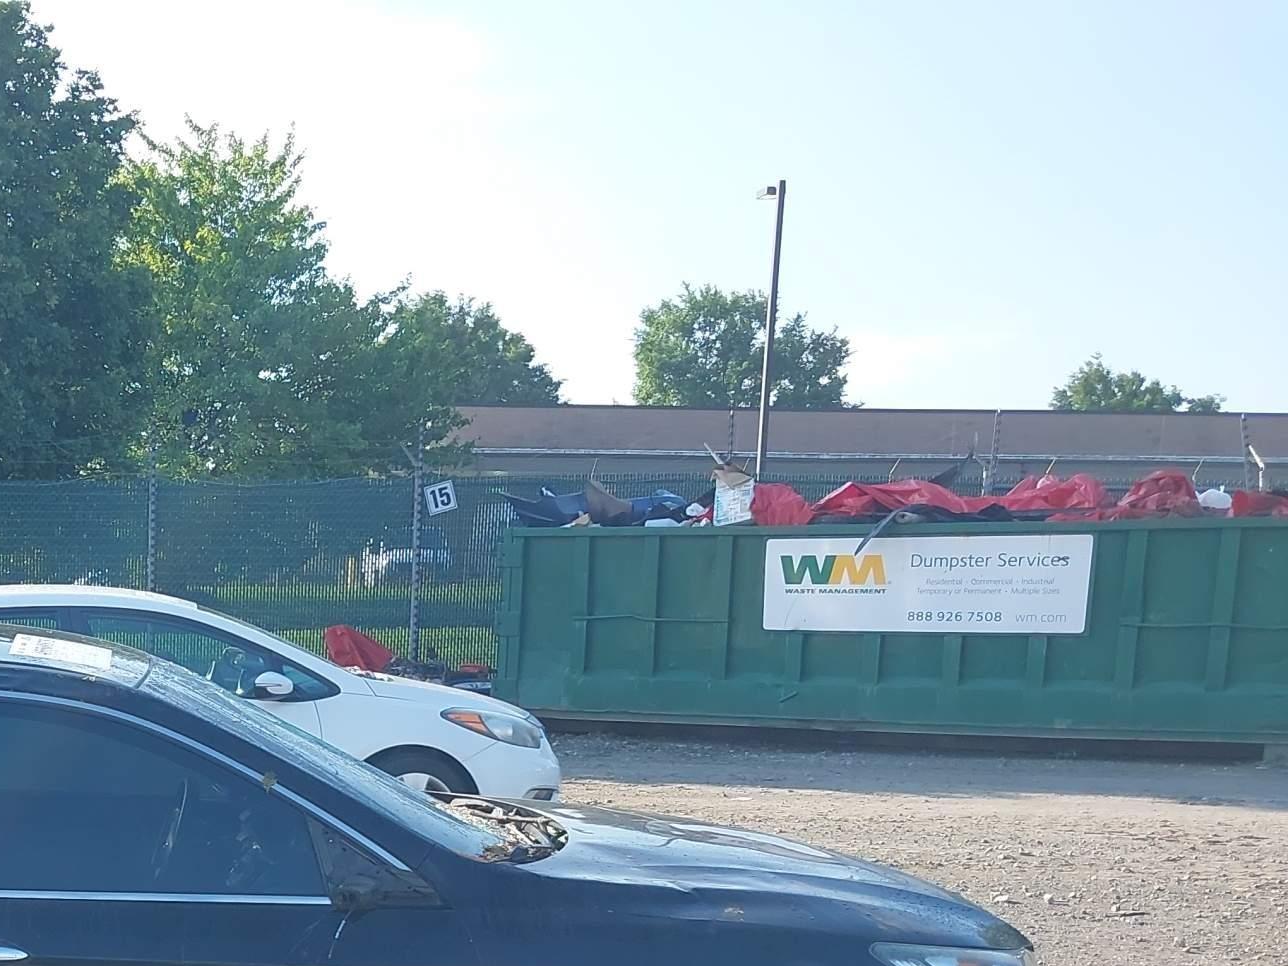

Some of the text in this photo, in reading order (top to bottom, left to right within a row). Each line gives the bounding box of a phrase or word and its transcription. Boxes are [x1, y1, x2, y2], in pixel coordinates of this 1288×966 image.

[429, 486, 451, 509] 15
[780, 554, 887, 585] WM
[910, 552, 1070, 571] Dumpster Services
[1021, 577, 1055, 585] Industrial
[907, 611, 1067, 623] 888 926 7508 wmcom
